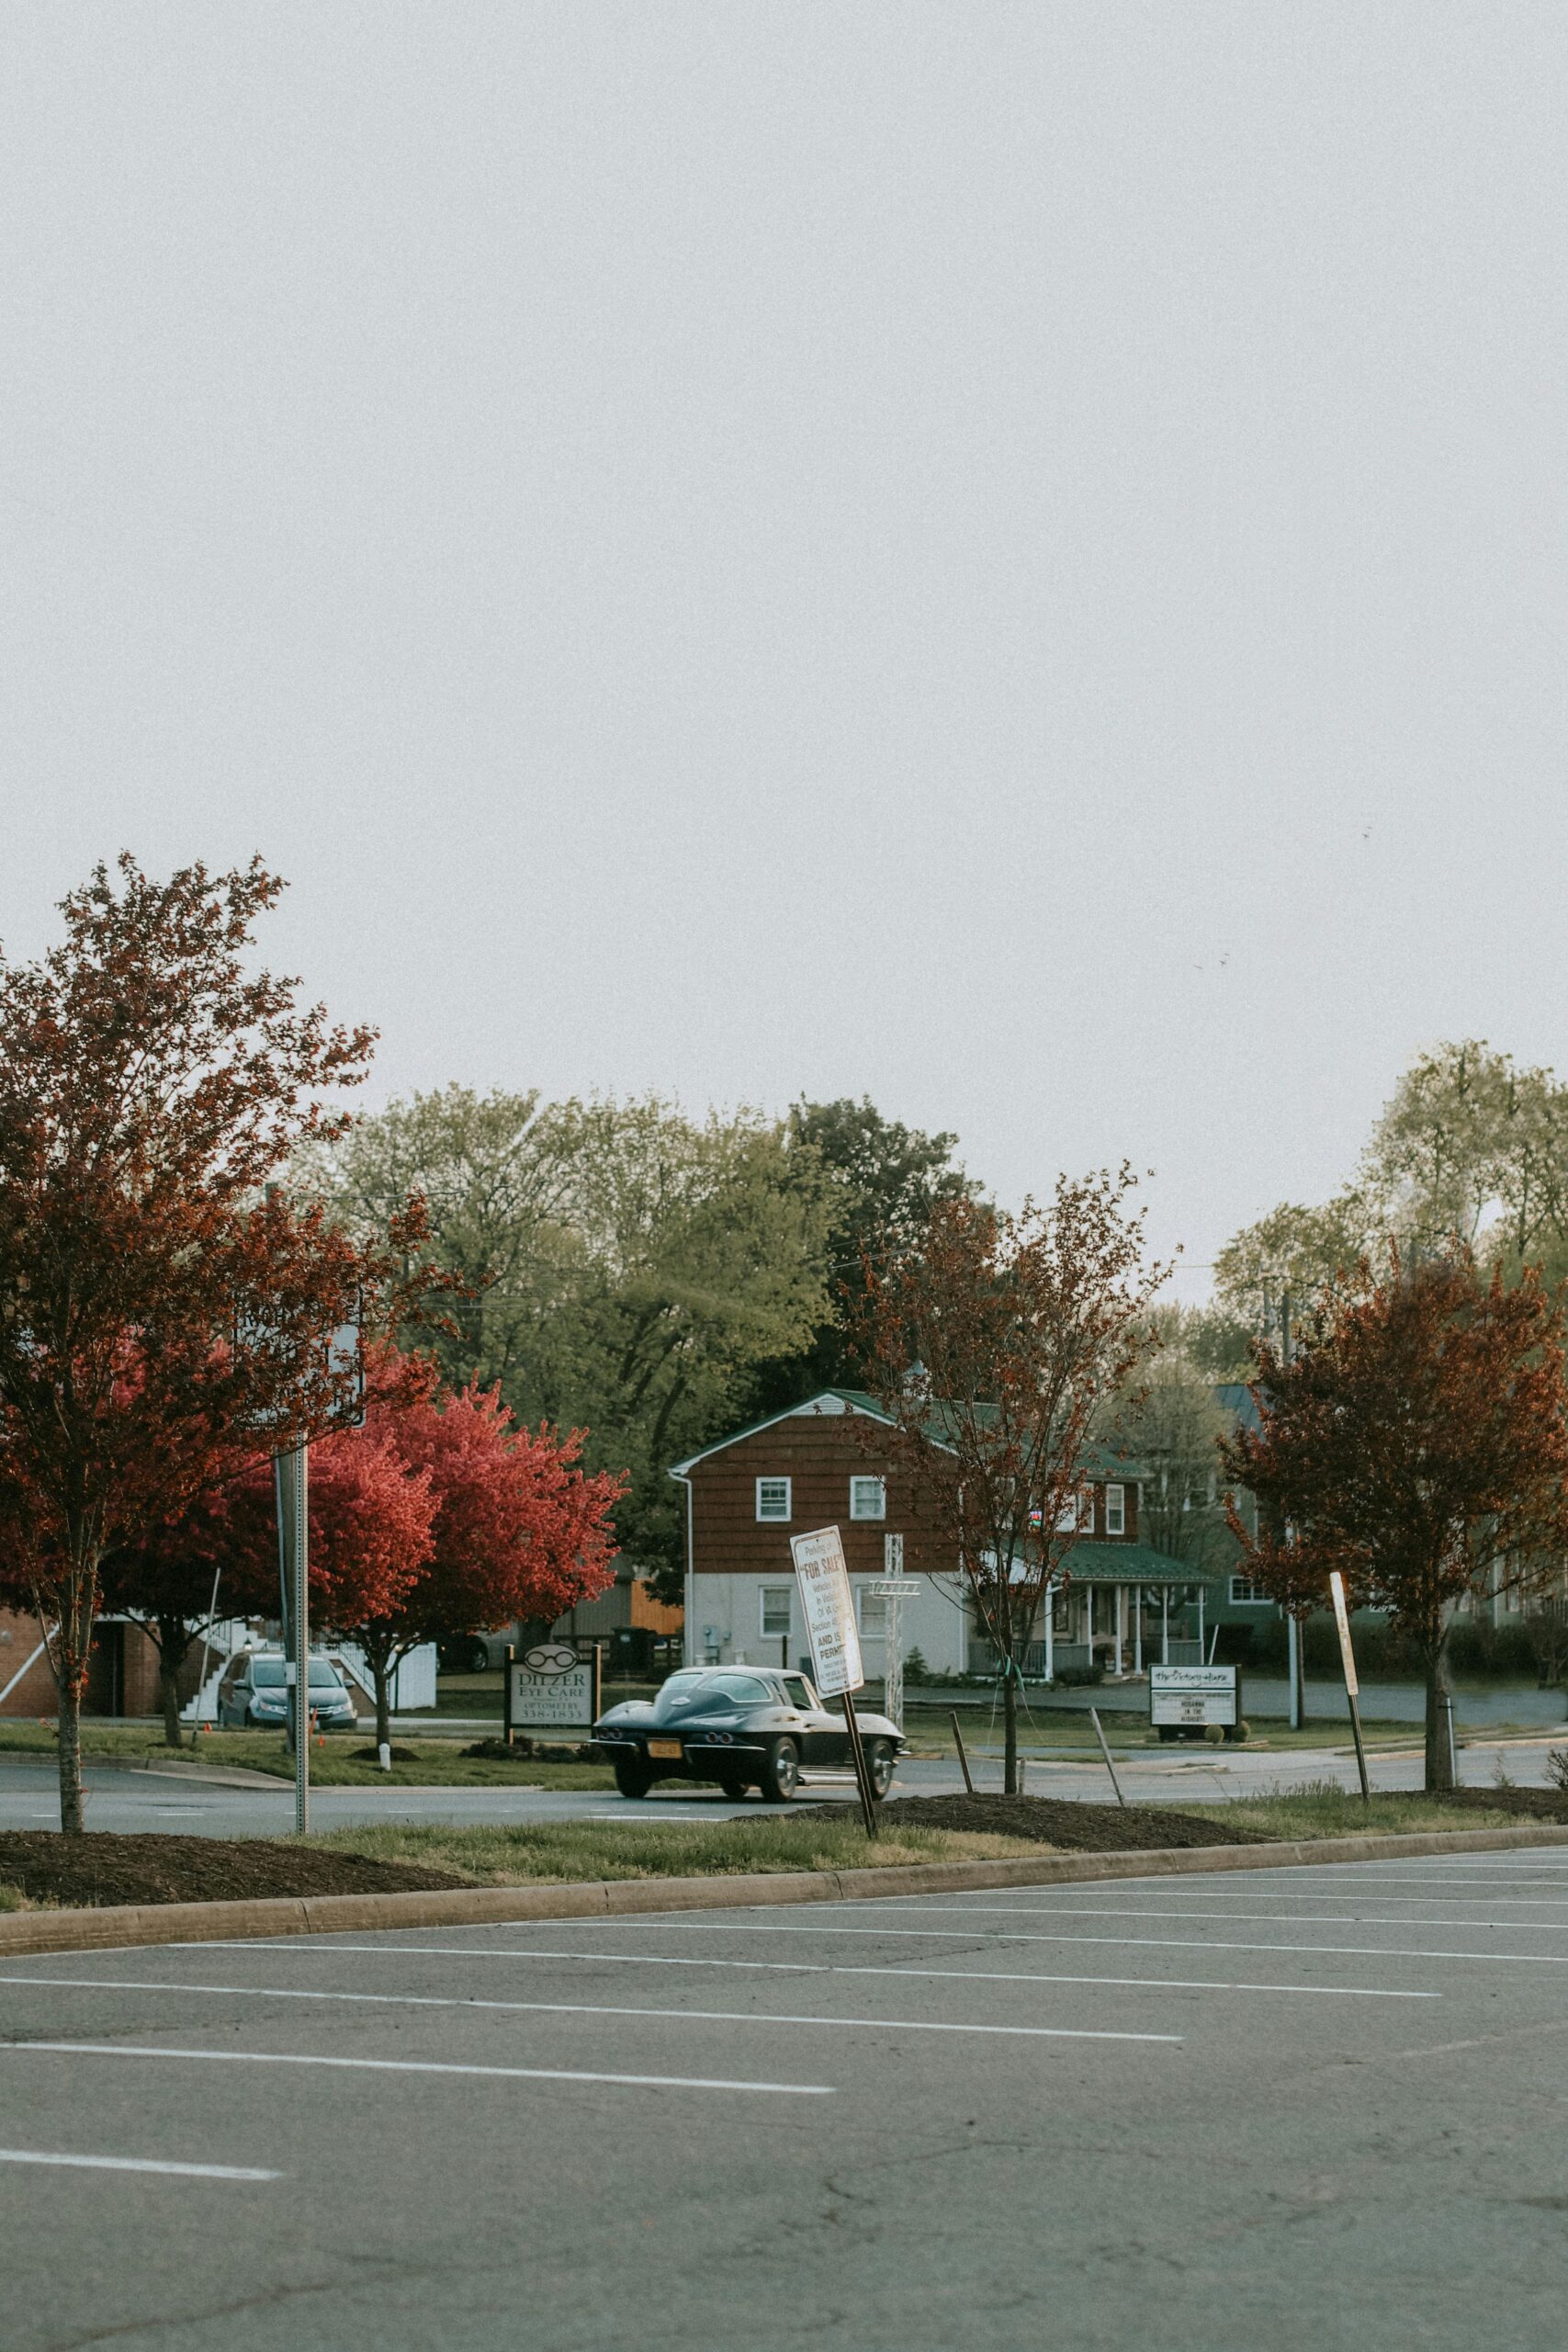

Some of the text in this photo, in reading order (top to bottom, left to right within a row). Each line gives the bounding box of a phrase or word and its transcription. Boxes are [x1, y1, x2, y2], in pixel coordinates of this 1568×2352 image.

[805, 1544, 826, 1556] Parking
[818, 1631, 841, 1646] AND IS
